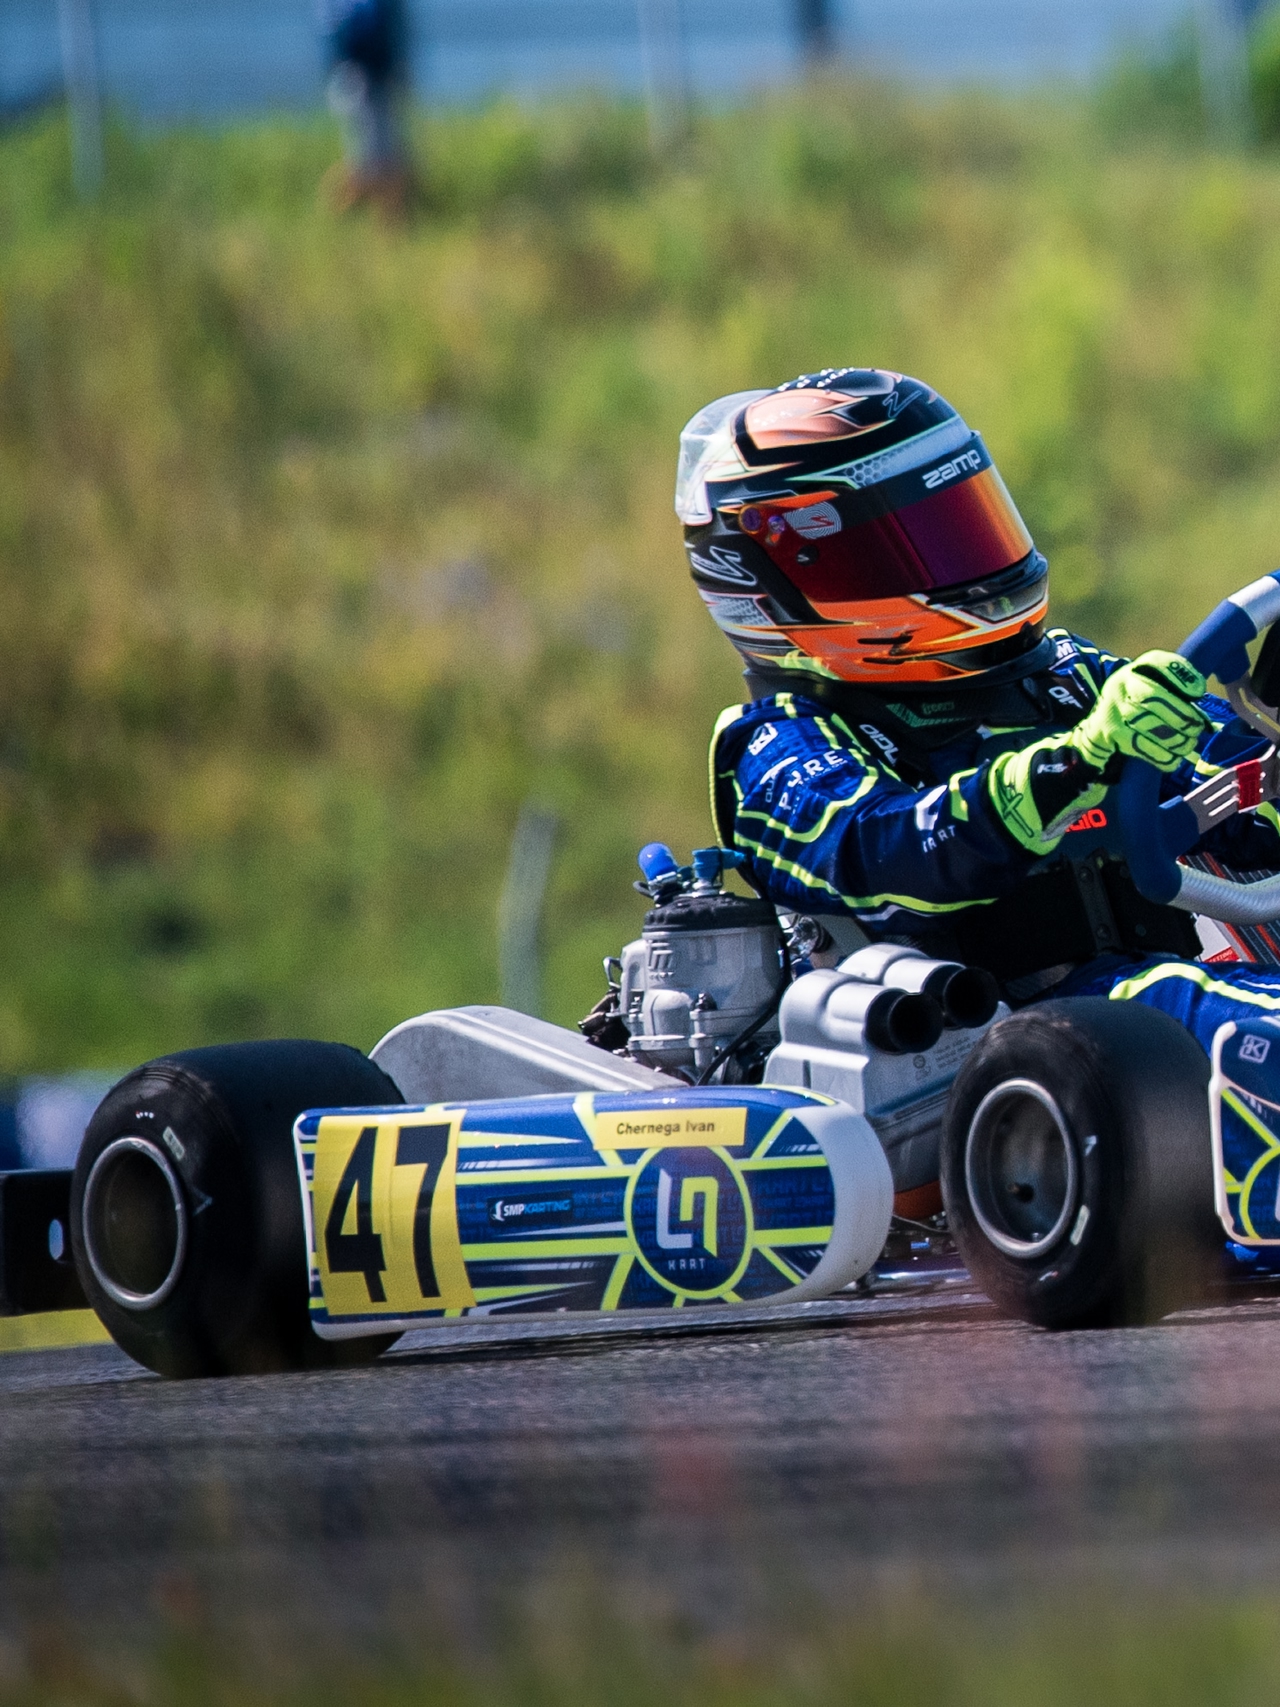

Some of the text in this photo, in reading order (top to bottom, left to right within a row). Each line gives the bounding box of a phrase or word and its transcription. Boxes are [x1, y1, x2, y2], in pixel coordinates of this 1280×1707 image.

[922, 449, 981, 489] zamp
[1169, 661, 1196, 684] OMP
[616, 1120, 715, 1135] Chernega Ivan
[325, 1122, 452, 1303] 47
[668, 1258, 706, 1271] KART
